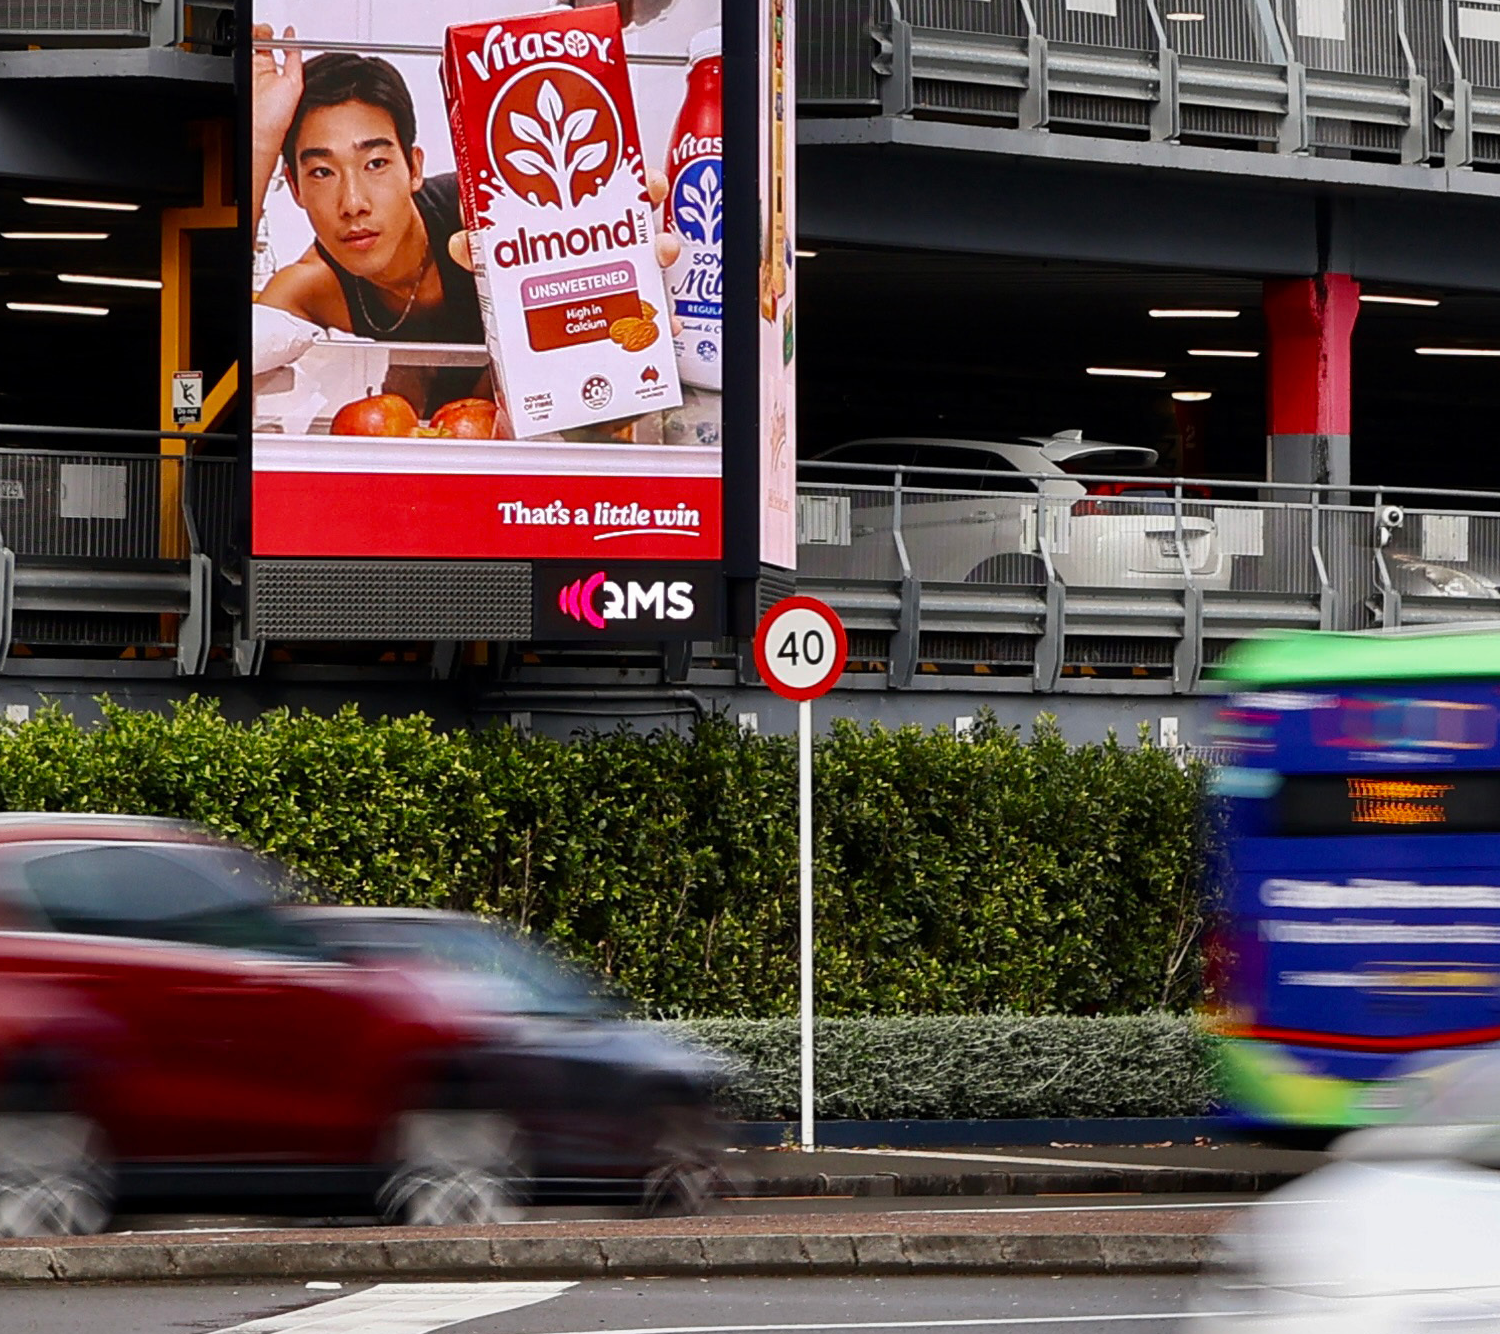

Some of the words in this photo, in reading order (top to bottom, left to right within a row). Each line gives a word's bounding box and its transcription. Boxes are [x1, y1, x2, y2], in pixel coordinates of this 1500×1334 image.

[672, 131, 723, 166] Vitas
[494, 208, 638, 267] almond
[635, 210, 650, 245] MILK
[528, 269, 631, 301] UNSWEETENED
[670, 267, 723, 303] Mil
[565, 305, 591, 322] High
[592, 304, 603, 315] in
[565, 317, 608, 335] Calcium
[688, 304, 723, 316] REGULA
[498, 499, 570, 525] That's
[574, 508, 590, 525] a
[593, 501, 650, 526] little
[654, 503, 700, 526] win
[581, 571, 695, 629] QMS
[776, 629, 825, 667] 40
